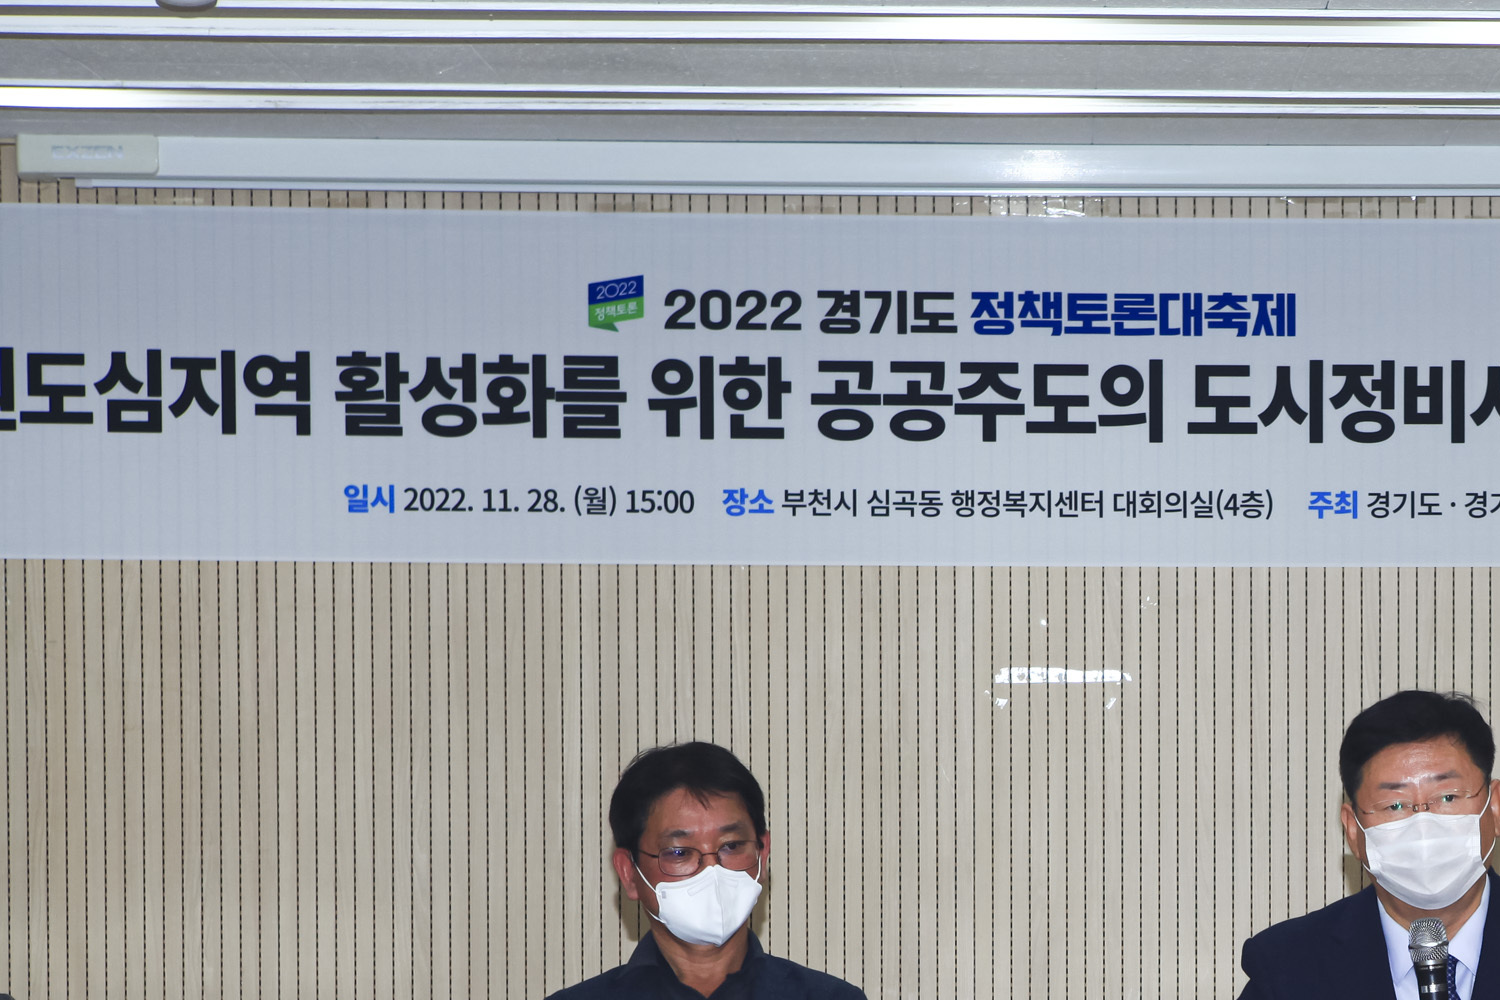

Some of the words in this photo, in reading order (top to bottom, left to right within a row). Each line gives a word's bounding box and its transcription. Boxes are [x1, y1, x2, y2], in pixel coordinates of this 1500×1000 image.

[51, 145, 123, 159] EXZEN
[596, 281, 637, 300] 2022
[595, 301, 638, 321] 정책토론
[664, 289, 802, 330] 2022
[817, 290, 957, 334] 경기도
[971, 291, 1296, 337] 정책토론대축제
[335, 351, 627, 439] 활성화를
[648, 356, 791, 440] 위한
[811, 359, 1163, 443] 공공주도의
[344, 484, 394, 513] 일시
[404, 488, 473, 511] 2022.
[483, 489, 519, 512] 11.
[528, 489, 565, 512] 28.
[575, 485, 616, 516] (월)
[626, 490, 694, 513] 15:00
[722, 488, 774, 516] 장소
[782, 489, 856, 517] 부천시
[867, 489, 943, 517] 심곡동
[951, 490, 1103, 518] 행정복지센터
[1114, 489, 1272, 520] 대회의실(4층)
[1308, 491, 1357, 519] 주최
[1367, 491, 1442, 518] 경기도
